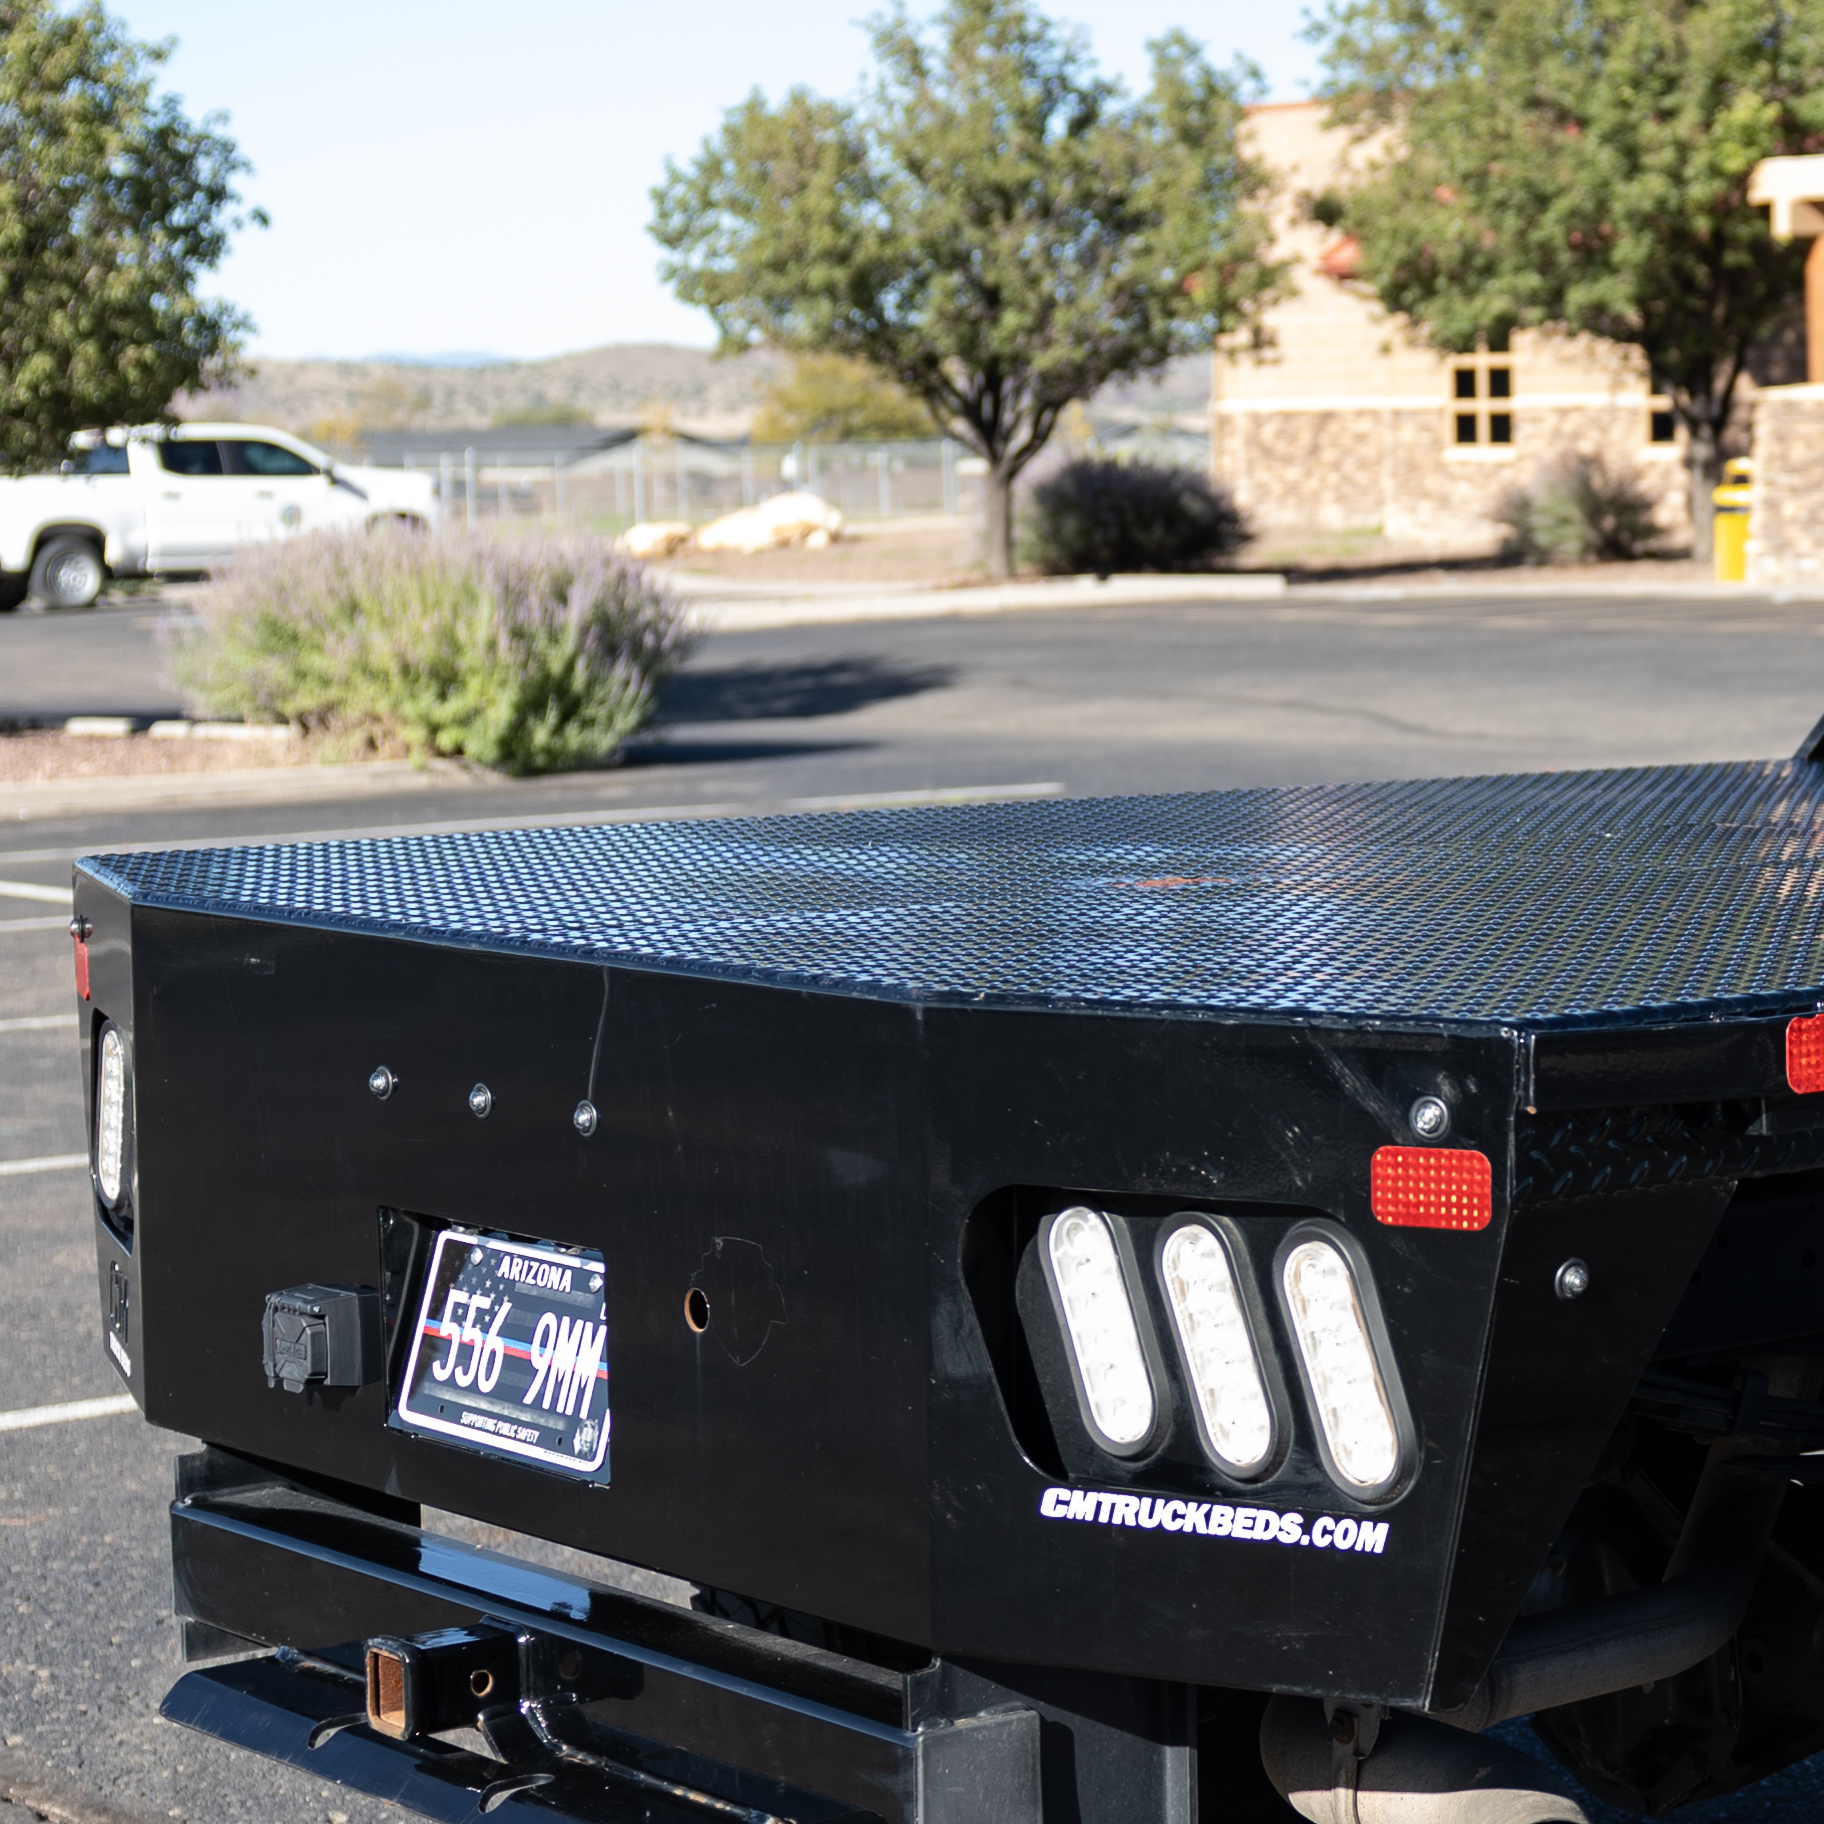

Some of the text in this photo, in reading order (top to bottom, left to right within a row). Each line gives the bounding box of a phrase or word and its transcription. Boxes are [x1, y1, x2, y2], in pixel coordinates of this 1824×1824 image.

[497, 1256, 572, 1292] ARIZONA
[432, 1288, 608, 1419] 556 9MM
[516, 1427, 541, 1444] SAFETY
[1040, 1487, 1389, 1554] CMTRUCKBEDS.COM
